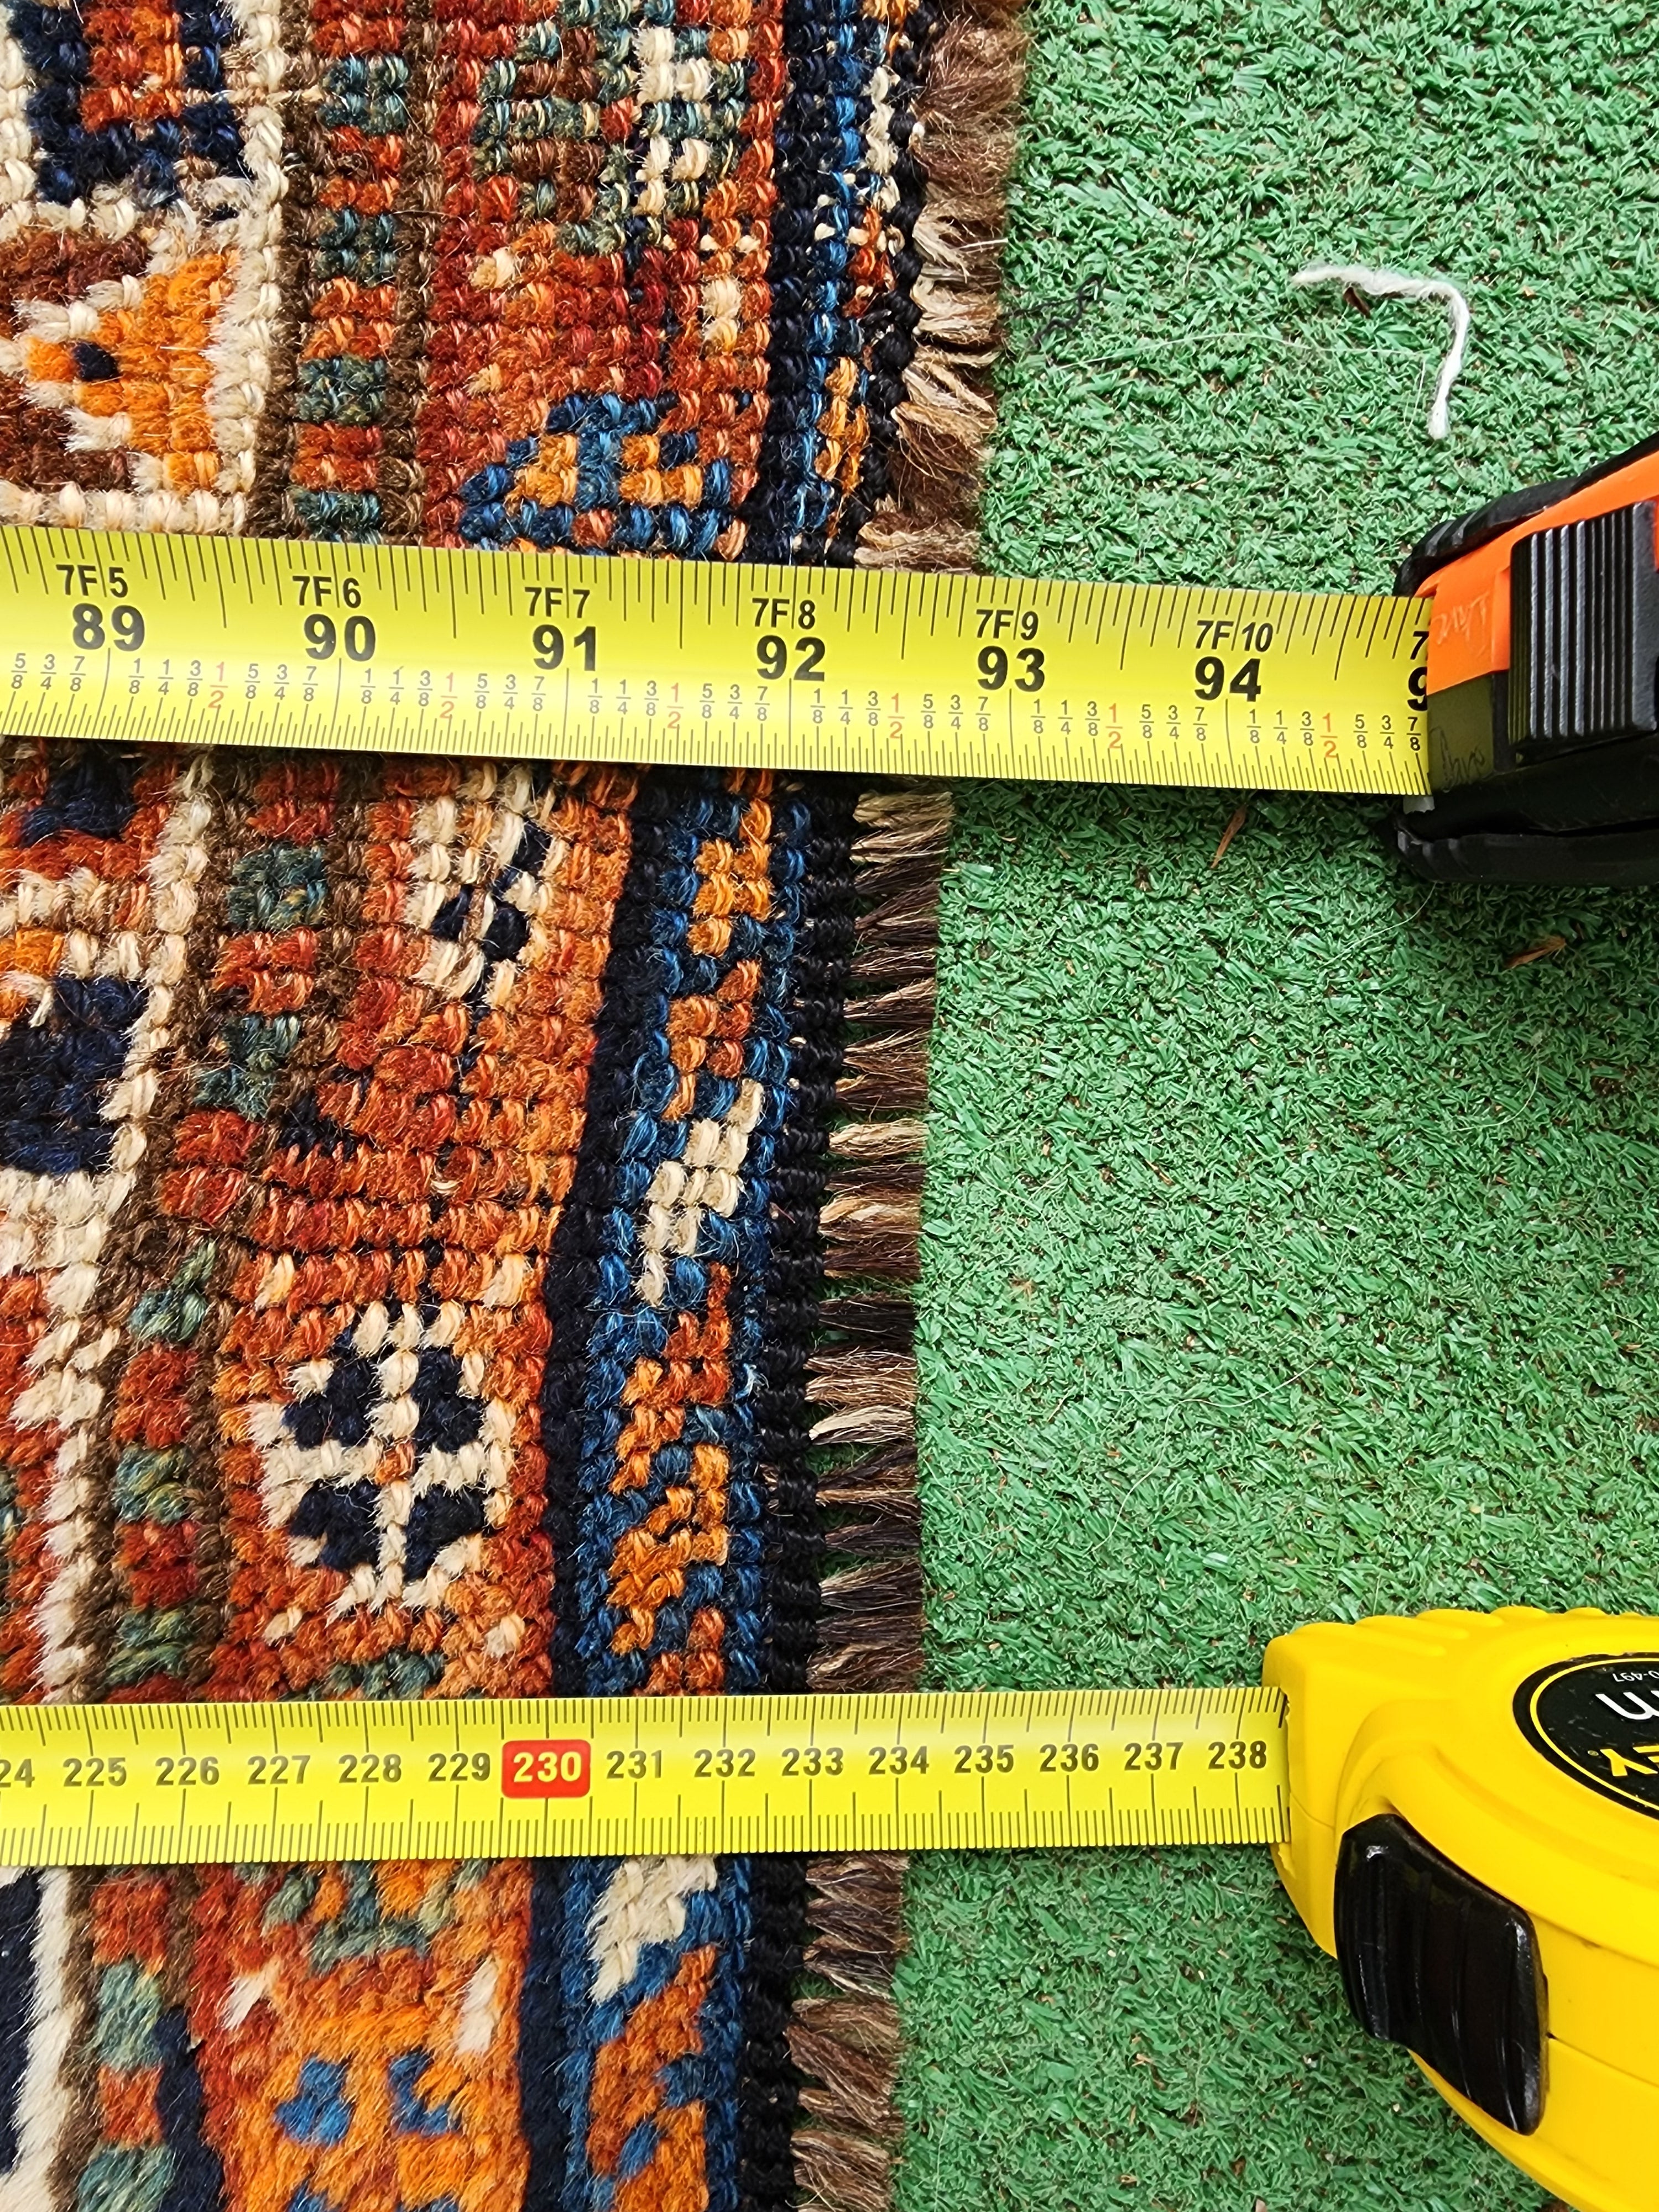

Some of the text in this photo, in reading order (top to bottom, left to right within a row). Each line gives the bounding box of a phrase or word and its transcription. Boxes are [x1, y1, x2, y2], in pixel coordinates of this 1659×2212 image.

[73, 603, 144, 651] 89
[304, 614, 375, 661] 90
[533, 624, 596, 671] 91
[757, 635, 825, 681] 92
[978, 646, 1045, 692] 93
[1195, 656, 1261, 702] 94
[0, 1741, 1266, 1787] 24 225 226 227 228 229 230 231 232 233 234 235 236 237 238
